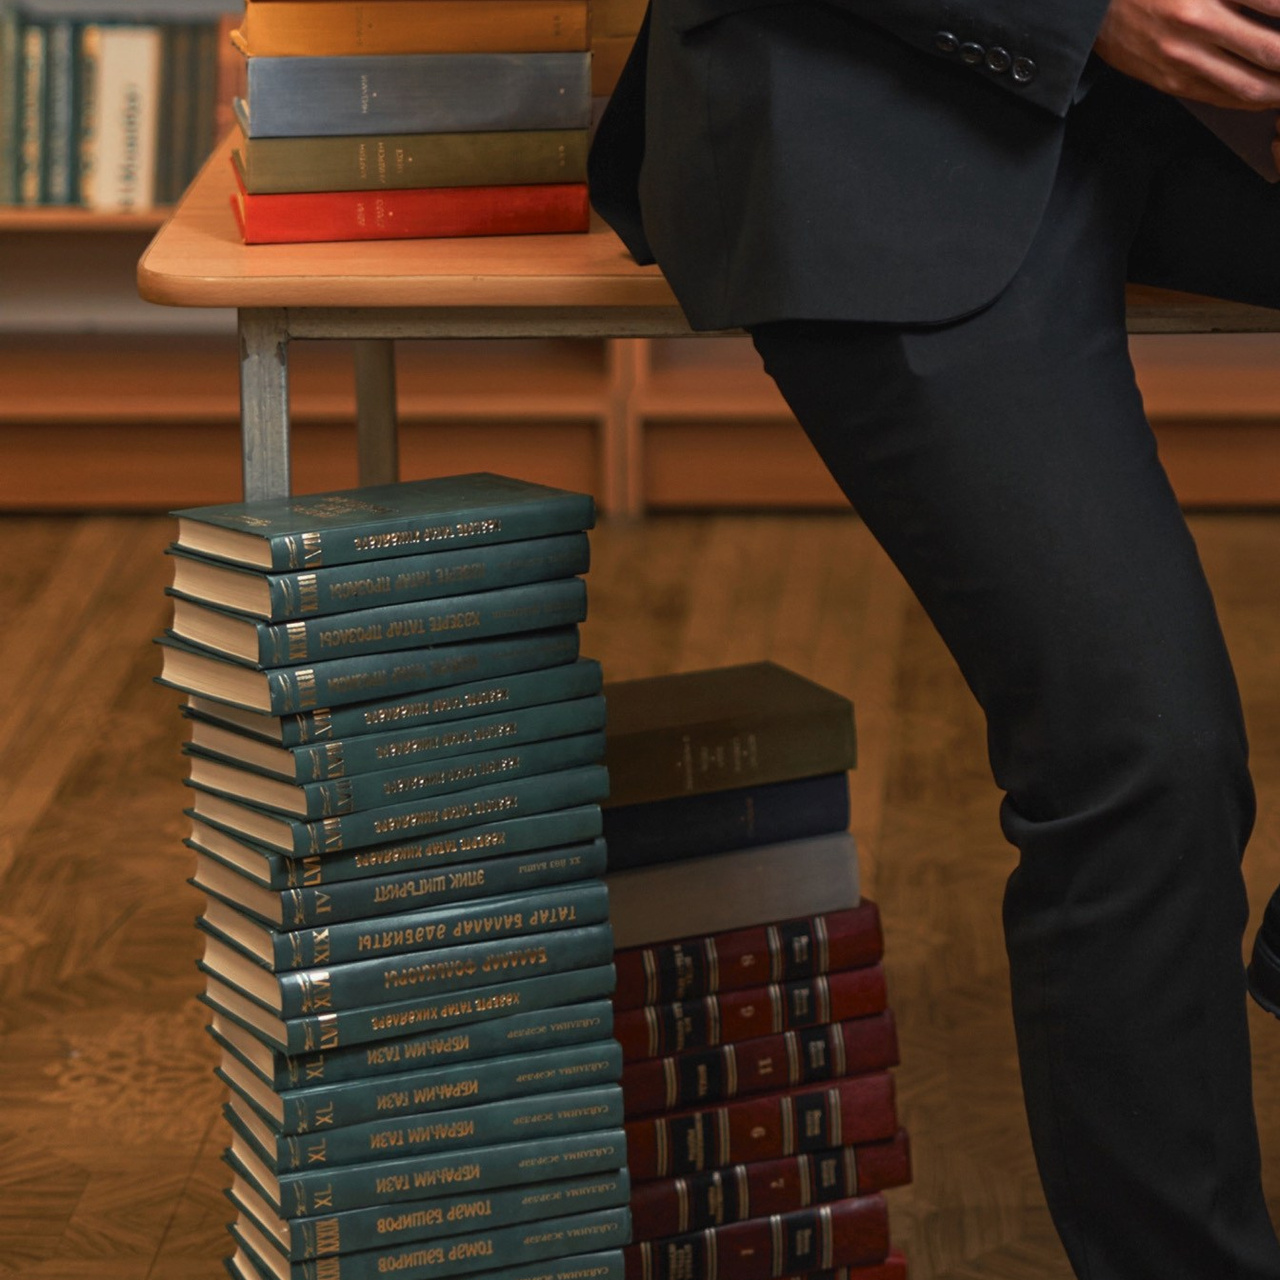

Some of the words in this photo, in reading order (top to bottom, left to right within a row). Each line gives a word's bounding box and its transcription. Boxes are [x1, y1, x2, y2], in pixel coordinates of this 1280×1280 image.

[318, 623, 383, 647] ПРОЗАСЫ
[385, 617, 426, 639] ТАТАР
[423, 838, 458, 856] ТАТАР
[371, 875, 448, 903] ШИГЪРИЯТ
[447, 868, 486, 889] ЭПИК
[315, 890, 332, 914] IV
[451, 912, 524, 937] БАЛАЛАР
[527, 904, 577, 926] ТАТАР
[312, 928, 330, 964] XIX
[356, 922, 448, 950] ӘДӘБИЯТЫ
[479, 945, 548, 973] БАЛАЛАР
[383, 956, 479, 989] ФОЛЬКЛОРЫ
[439, 1000, 473, 1018] ТАТАР
[473, 992, 521, 1011] ХӘЗЕРГЕ
[370, 1006, 439, 1030] ХИКӘЯЛӘРЕ
[402, 1034, 470, 1059] ИБРАҺИМ
[306, 1054, 324, 1081] XL
[411, 1078, 480, 1104] ИБРАҺИМ
[315, 1101, 334, 1126] XL
[407, 1119, 475, 1144] ИБРАҺИМ
[308, 1138, 327, 1163] XL
[413, 1162, 481, 1187] ИБРАҺИМ
[314, 1183, 333, 1210] XL
[374, 1207, 444, 1234] БӘШИРОВ
[445, 1199, 493, 1221] ГОМӘР
[375, 1247, 445, 1274] БӘШИРОВ
[447, 1238, 494, 1261] ГОМӘР
